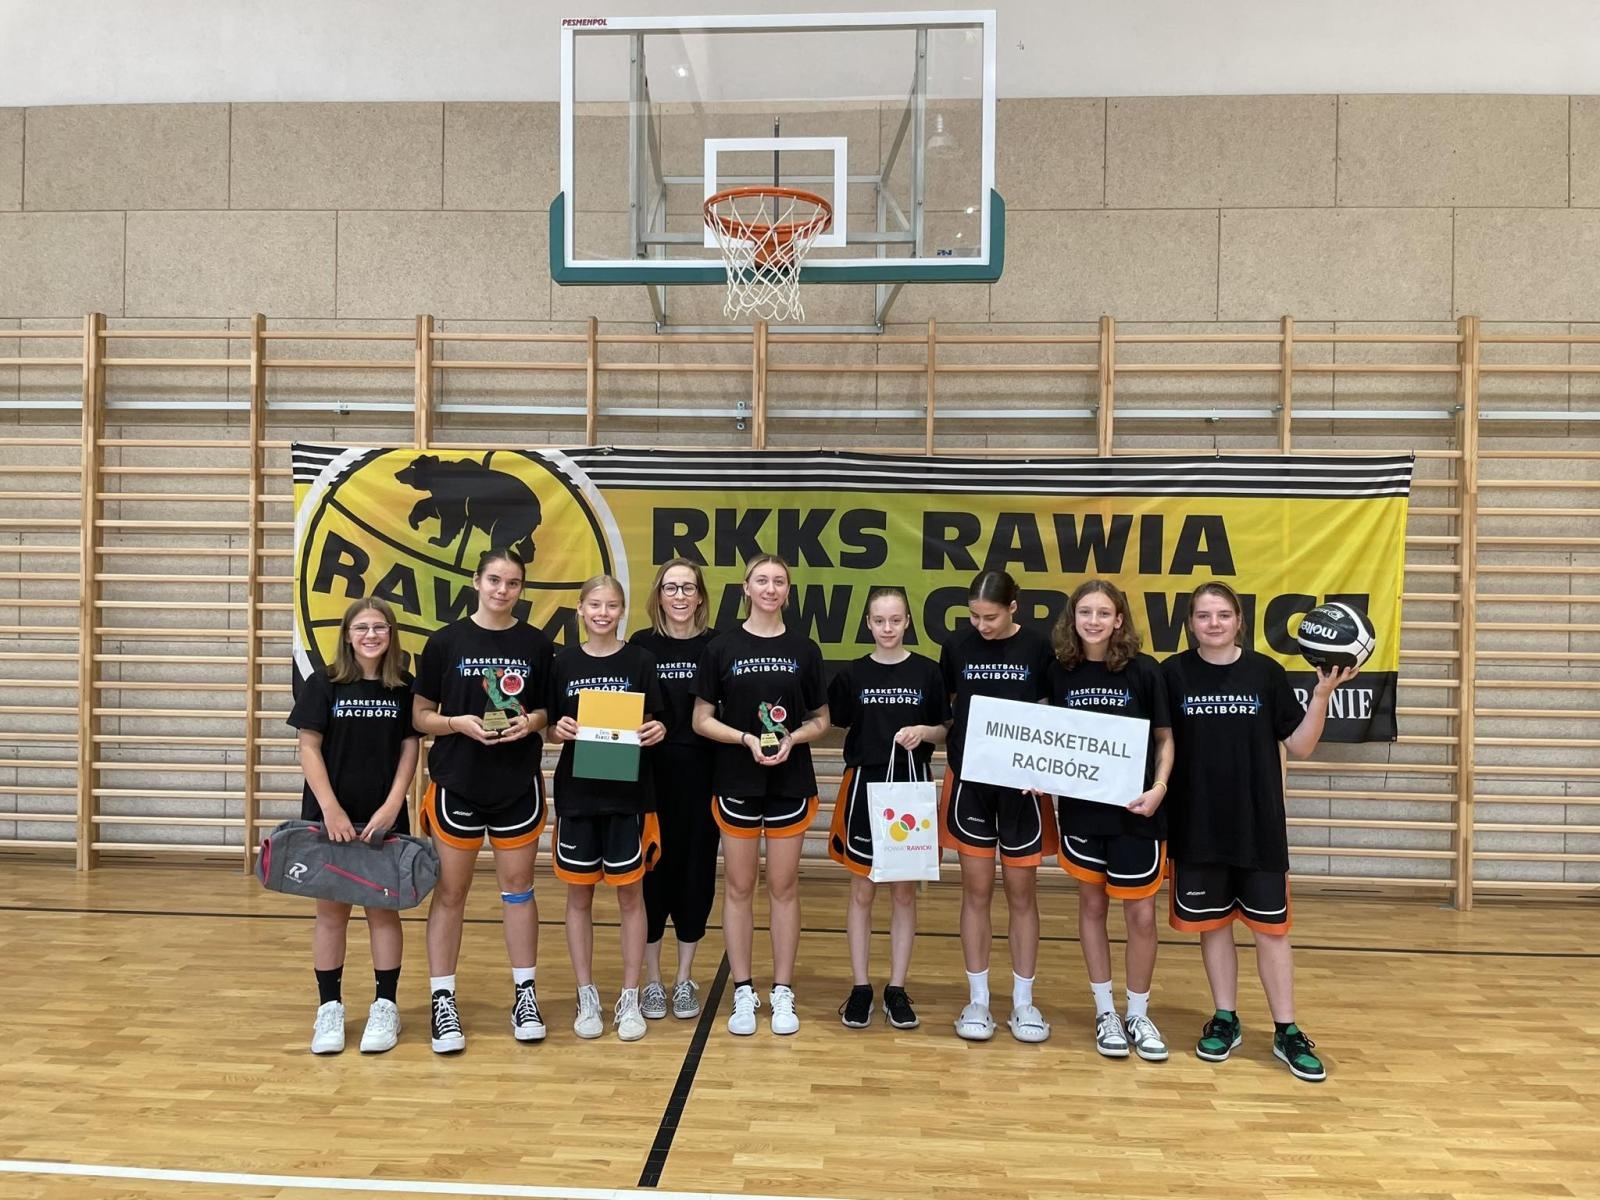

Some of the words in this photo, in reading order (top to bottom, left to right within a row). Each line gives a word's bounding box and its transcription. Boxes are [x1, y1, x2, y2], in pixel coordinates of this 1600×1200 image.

[562, 18, 608, 26] PESMENPOL
[652, 507, 889, 569] RKKS
[922, 511, 1237, 577] RAWIA
[464, 658, 527, 666] BASKETBALL
[737, 657, 792, 666] BASKETBALL
[736, 664, 794, 676] RACIBÓRZ
[966, 671, 1025, 681] RACIBÓRZ
[569, 677, 625, 687] BASKETBALL
[1070, 687, 1124, 696] BASKETBALL
[863, 695, 919, 705] RACIBÓRZ
[1069, 696, 1125, 707] RACIBÓRZ
[1187, 695, 1254, 703] BASKETBALL
[336, 707, 397, 718] RACIBÓRZ
[1187, 703, 1256, 715] RACIBÓRZ
[985, 720, 1131, 759] MINIBASKETBALL
[1012, 752, 1100, 782] RACIBÓRZ
